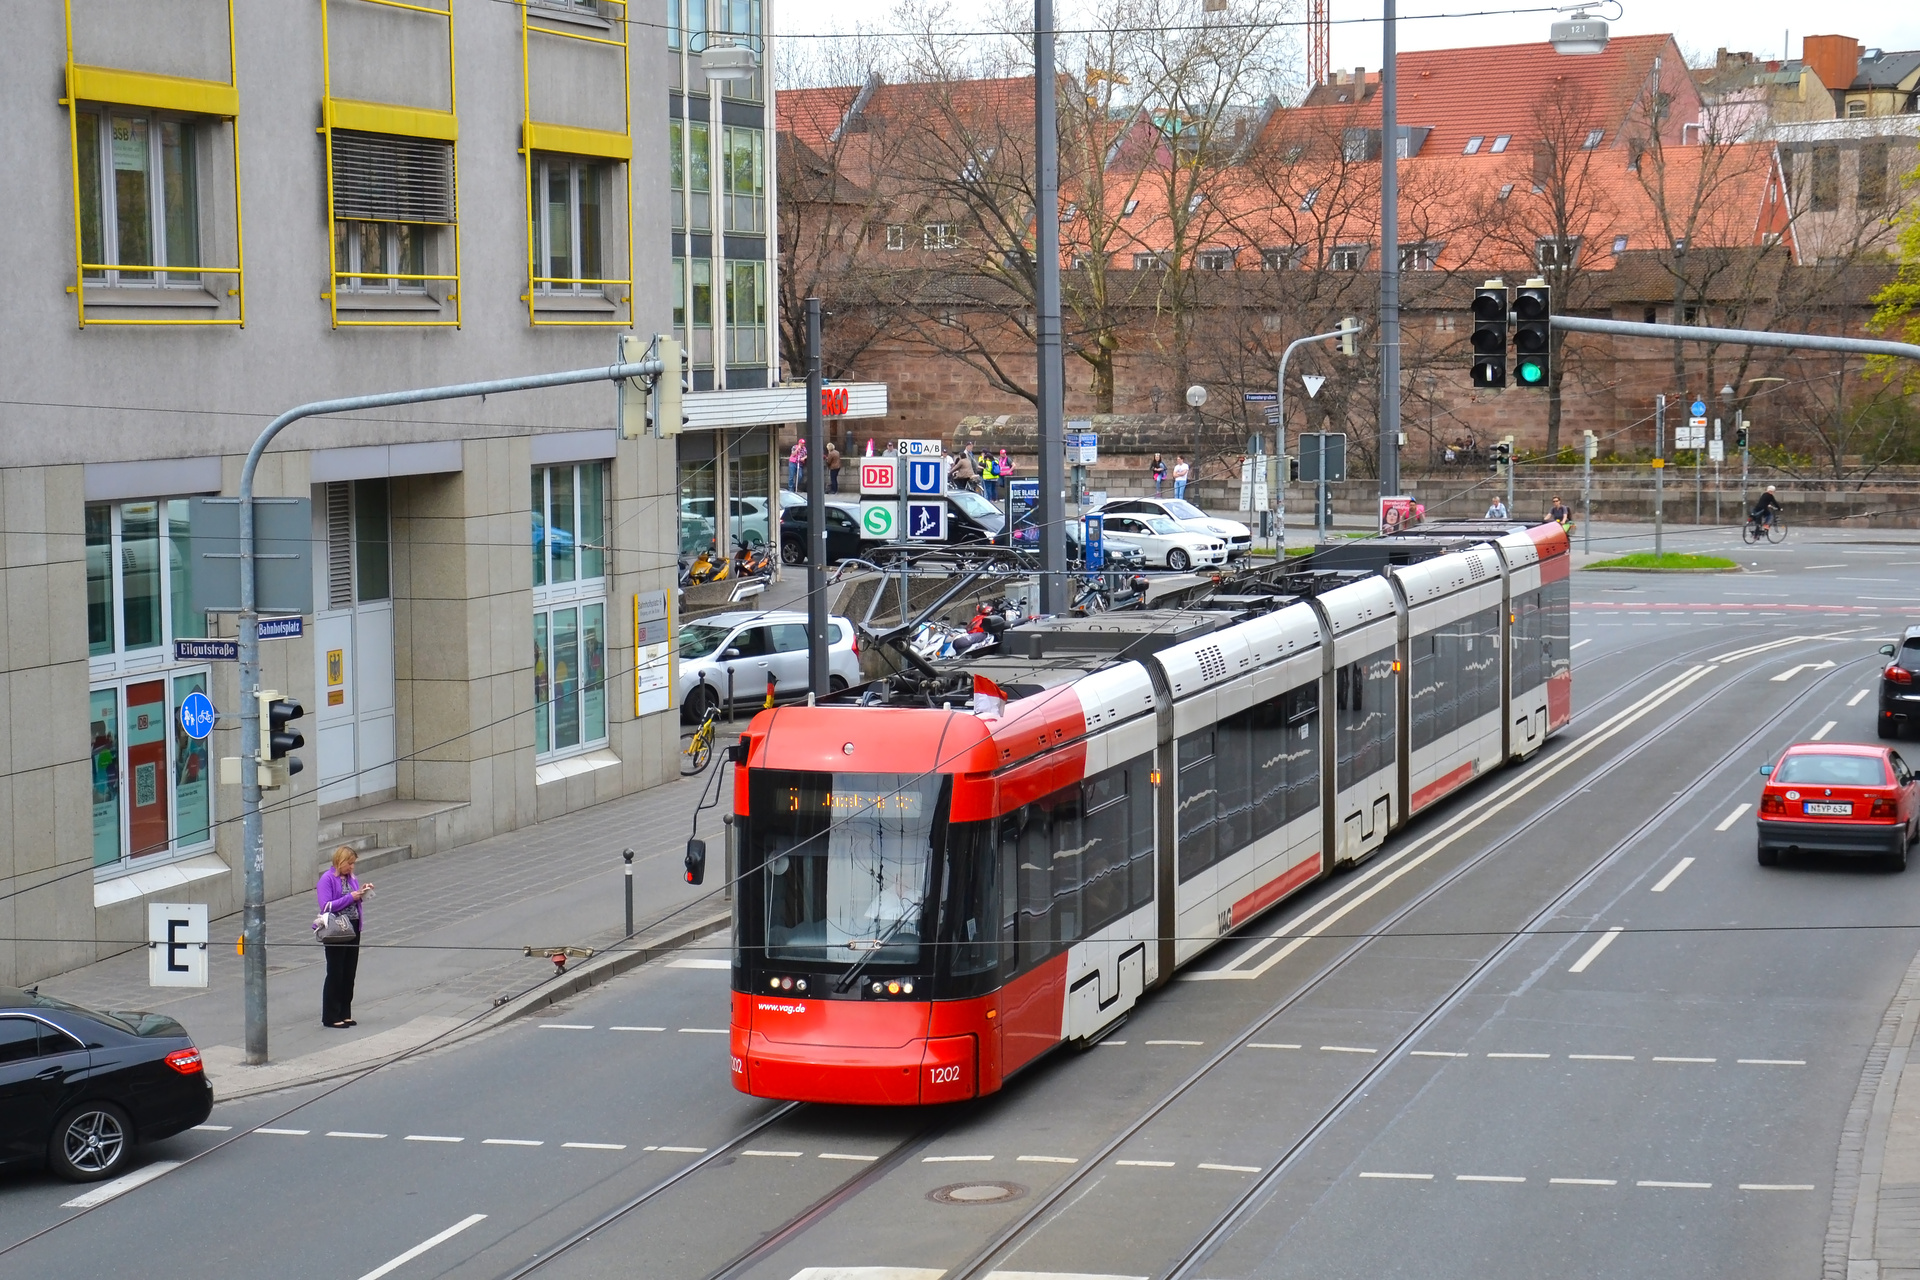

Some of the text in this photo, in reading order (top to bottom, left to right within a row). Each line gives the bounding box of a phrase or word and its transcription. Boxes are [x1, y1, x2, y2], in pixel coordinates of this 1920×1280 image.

[1571, 25, 1586, 34] 121
[821, 388, 848, 416] ERGO
[899, 442, 908, 454] 8
[910, 444, 922, 454] U1
[866, 468, 890, 485] DB
[916, 464, 935, 491] U
[868, 508, 887, 534] S
[258, 622, 300, 636] Bahnhofsplatz
[181, 643, 234, 657] Eilgutstraße
[168, 920, 189, 972] E
[758, 1003, 806, 1014] www.vag.de
[930, 1065, 960, 1084] 1202
